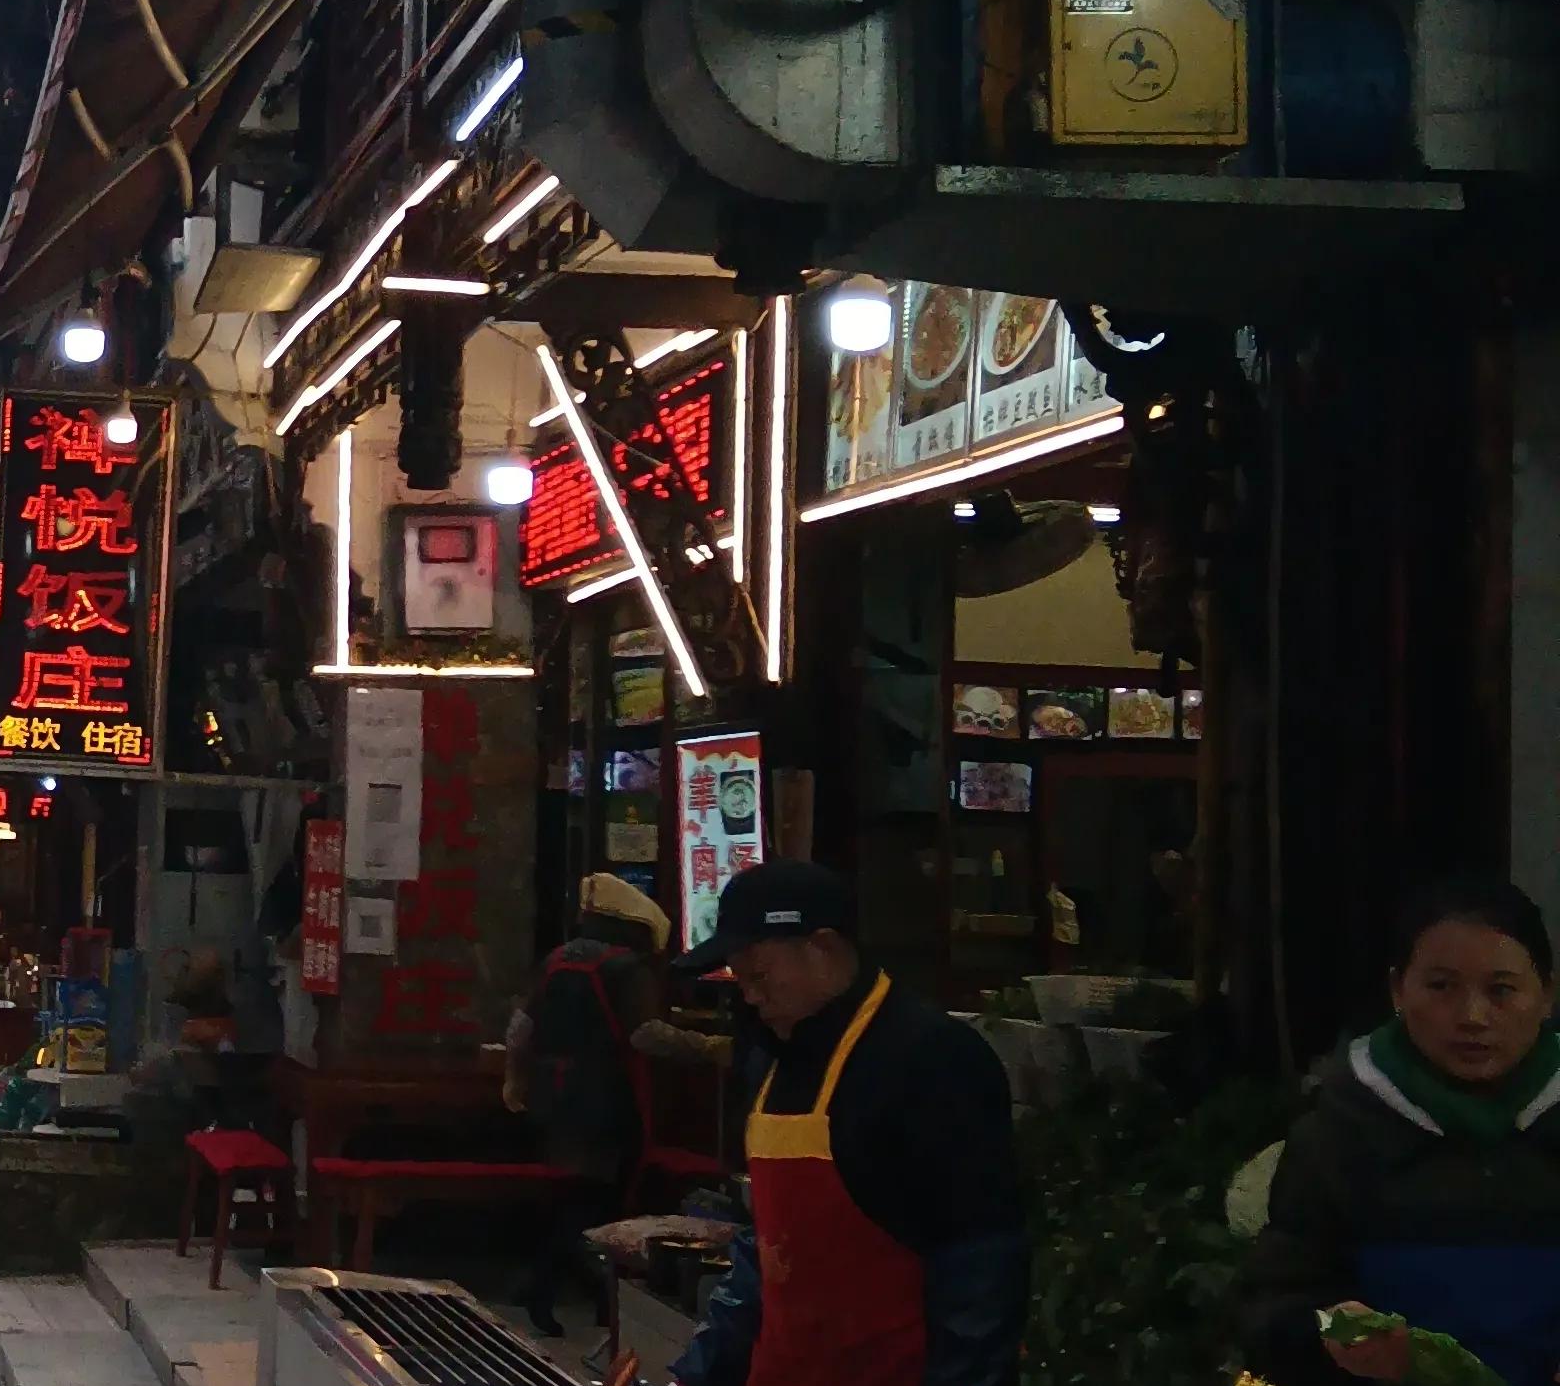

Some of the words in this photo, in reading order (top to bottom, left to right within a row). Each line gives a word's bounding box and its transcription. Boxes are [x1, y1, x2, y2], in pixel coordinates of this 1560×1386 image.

[10, 406, 139, 714] 禅悦饭庄
[80, 720, 143, 756] 住宿
